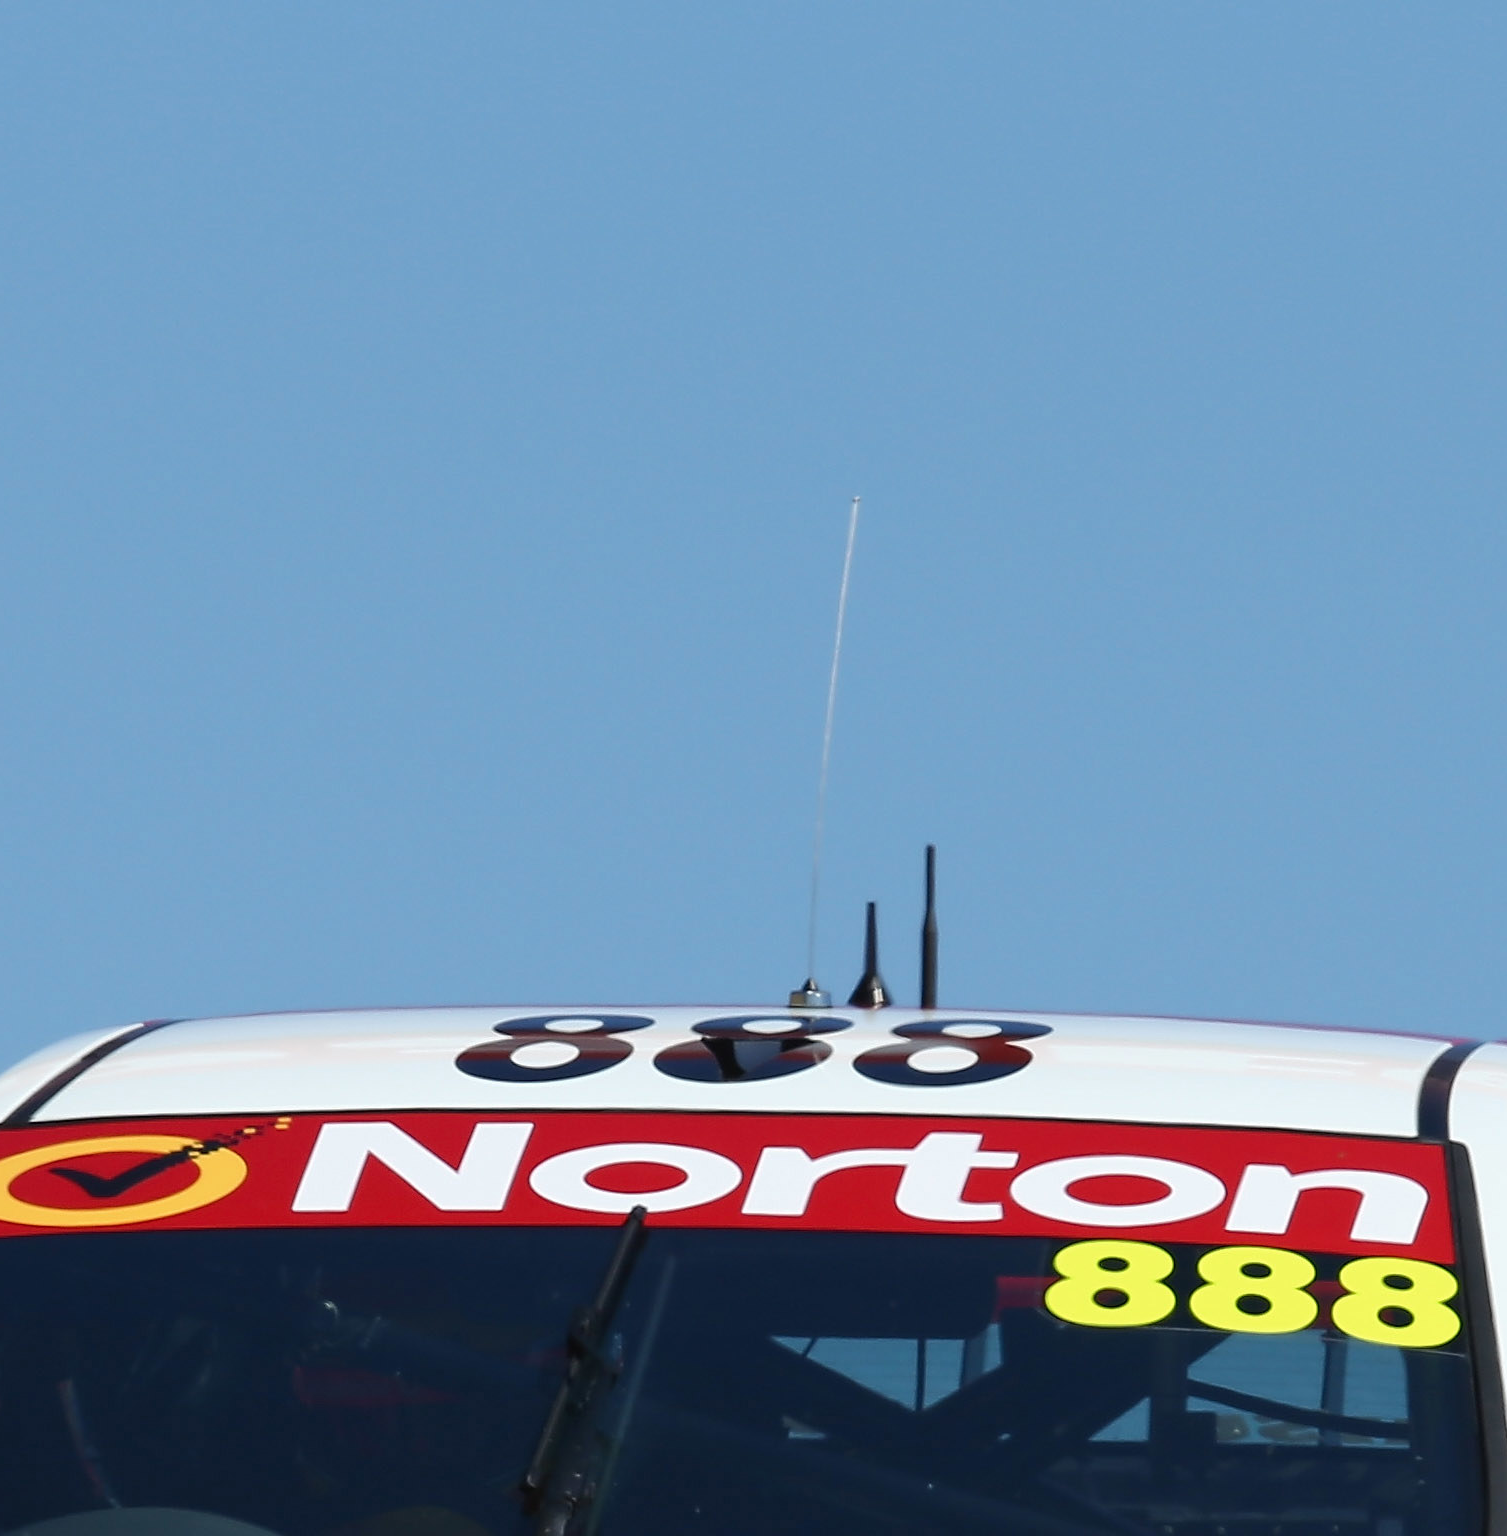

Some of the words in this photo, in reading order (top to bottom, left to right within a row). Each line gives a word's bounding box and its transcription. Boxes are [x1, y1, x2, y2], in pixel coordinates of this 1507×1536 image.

[454, 1014, 1053, 1087] 888
[290, 1121, 1430, 1244] Norton
[1043, 1240, 1462, 1348] 888
